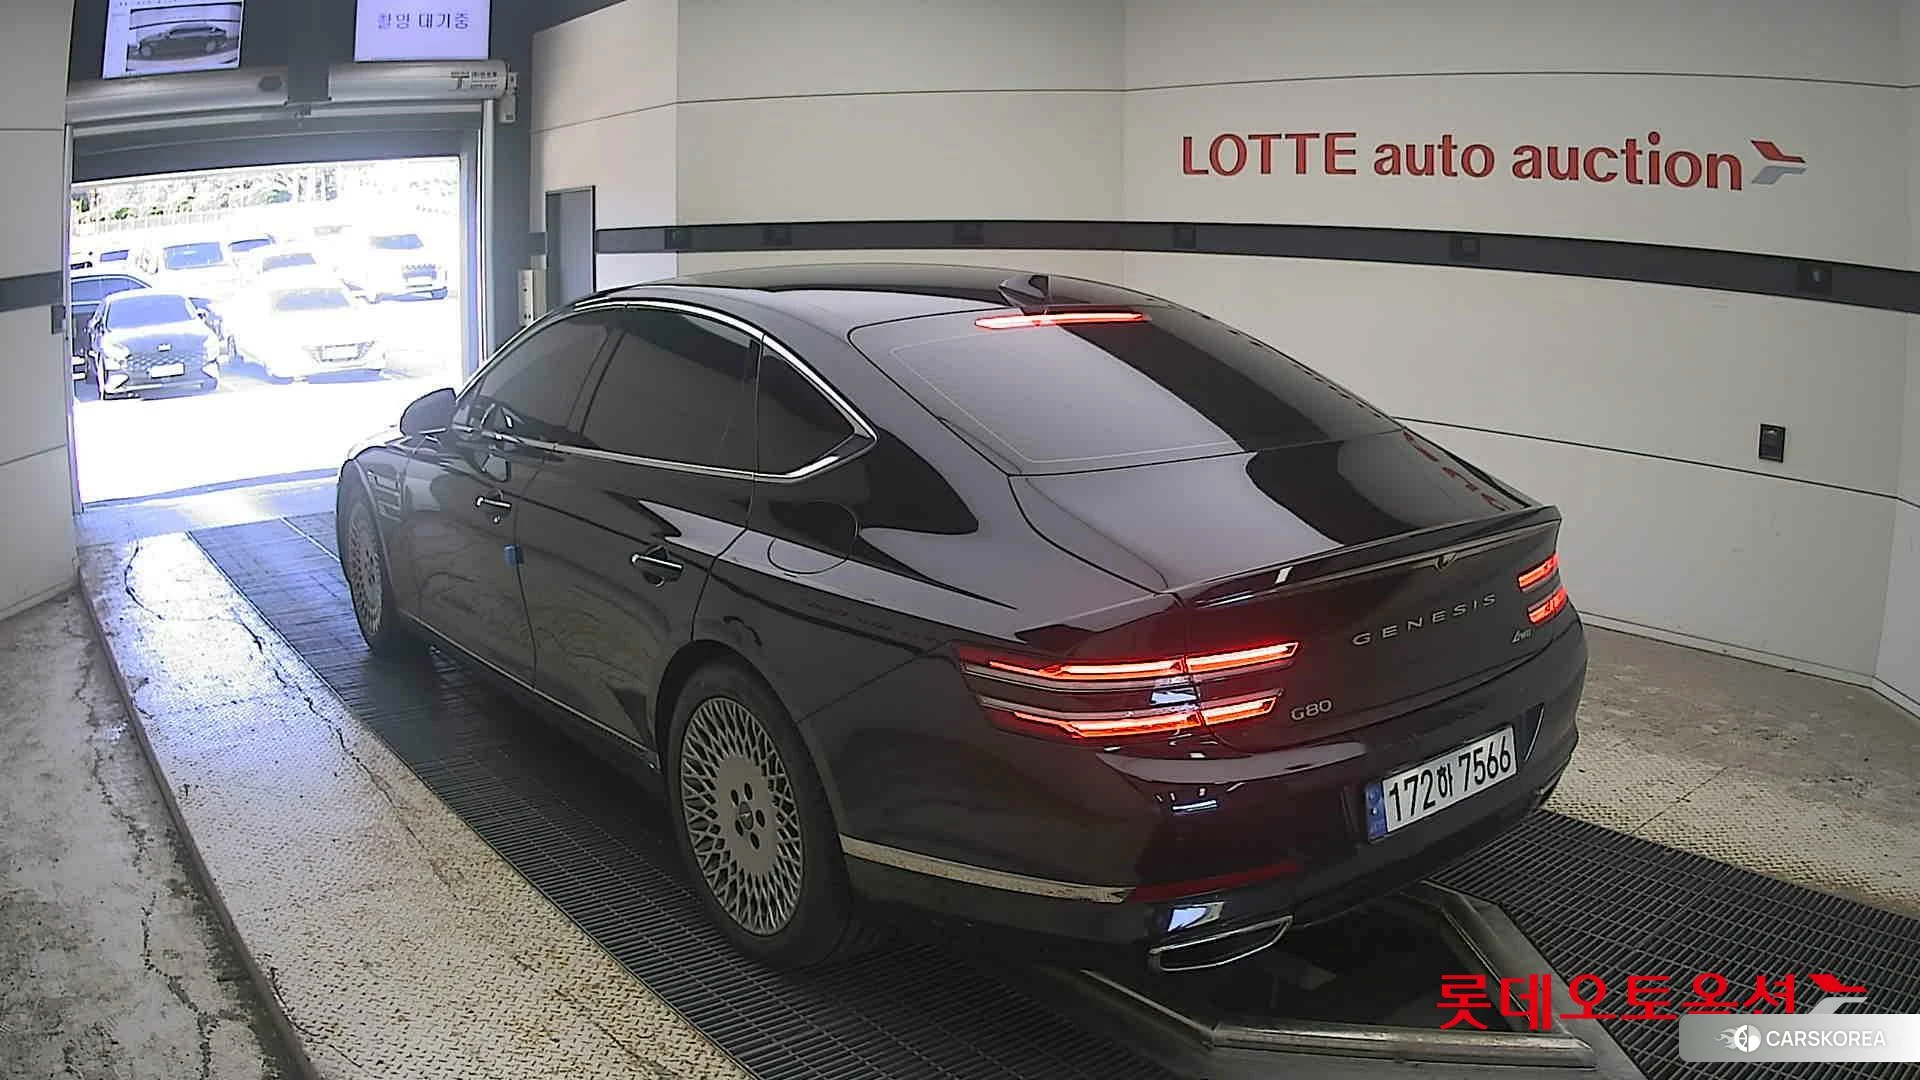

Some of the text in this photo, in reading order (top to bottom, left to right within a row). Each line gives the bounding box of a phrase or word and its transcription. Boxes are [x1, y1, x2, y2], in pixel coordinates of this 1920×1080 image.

[418, 13, 470, 29] 대기중
[1182, 131, 1742, 190] LOTTE auto auction
[1352, 594, 1496, 646] GENESIS
[1291, 699, 1332, 720] G80
[1389, 736, 1511, 821] 172하 7566
